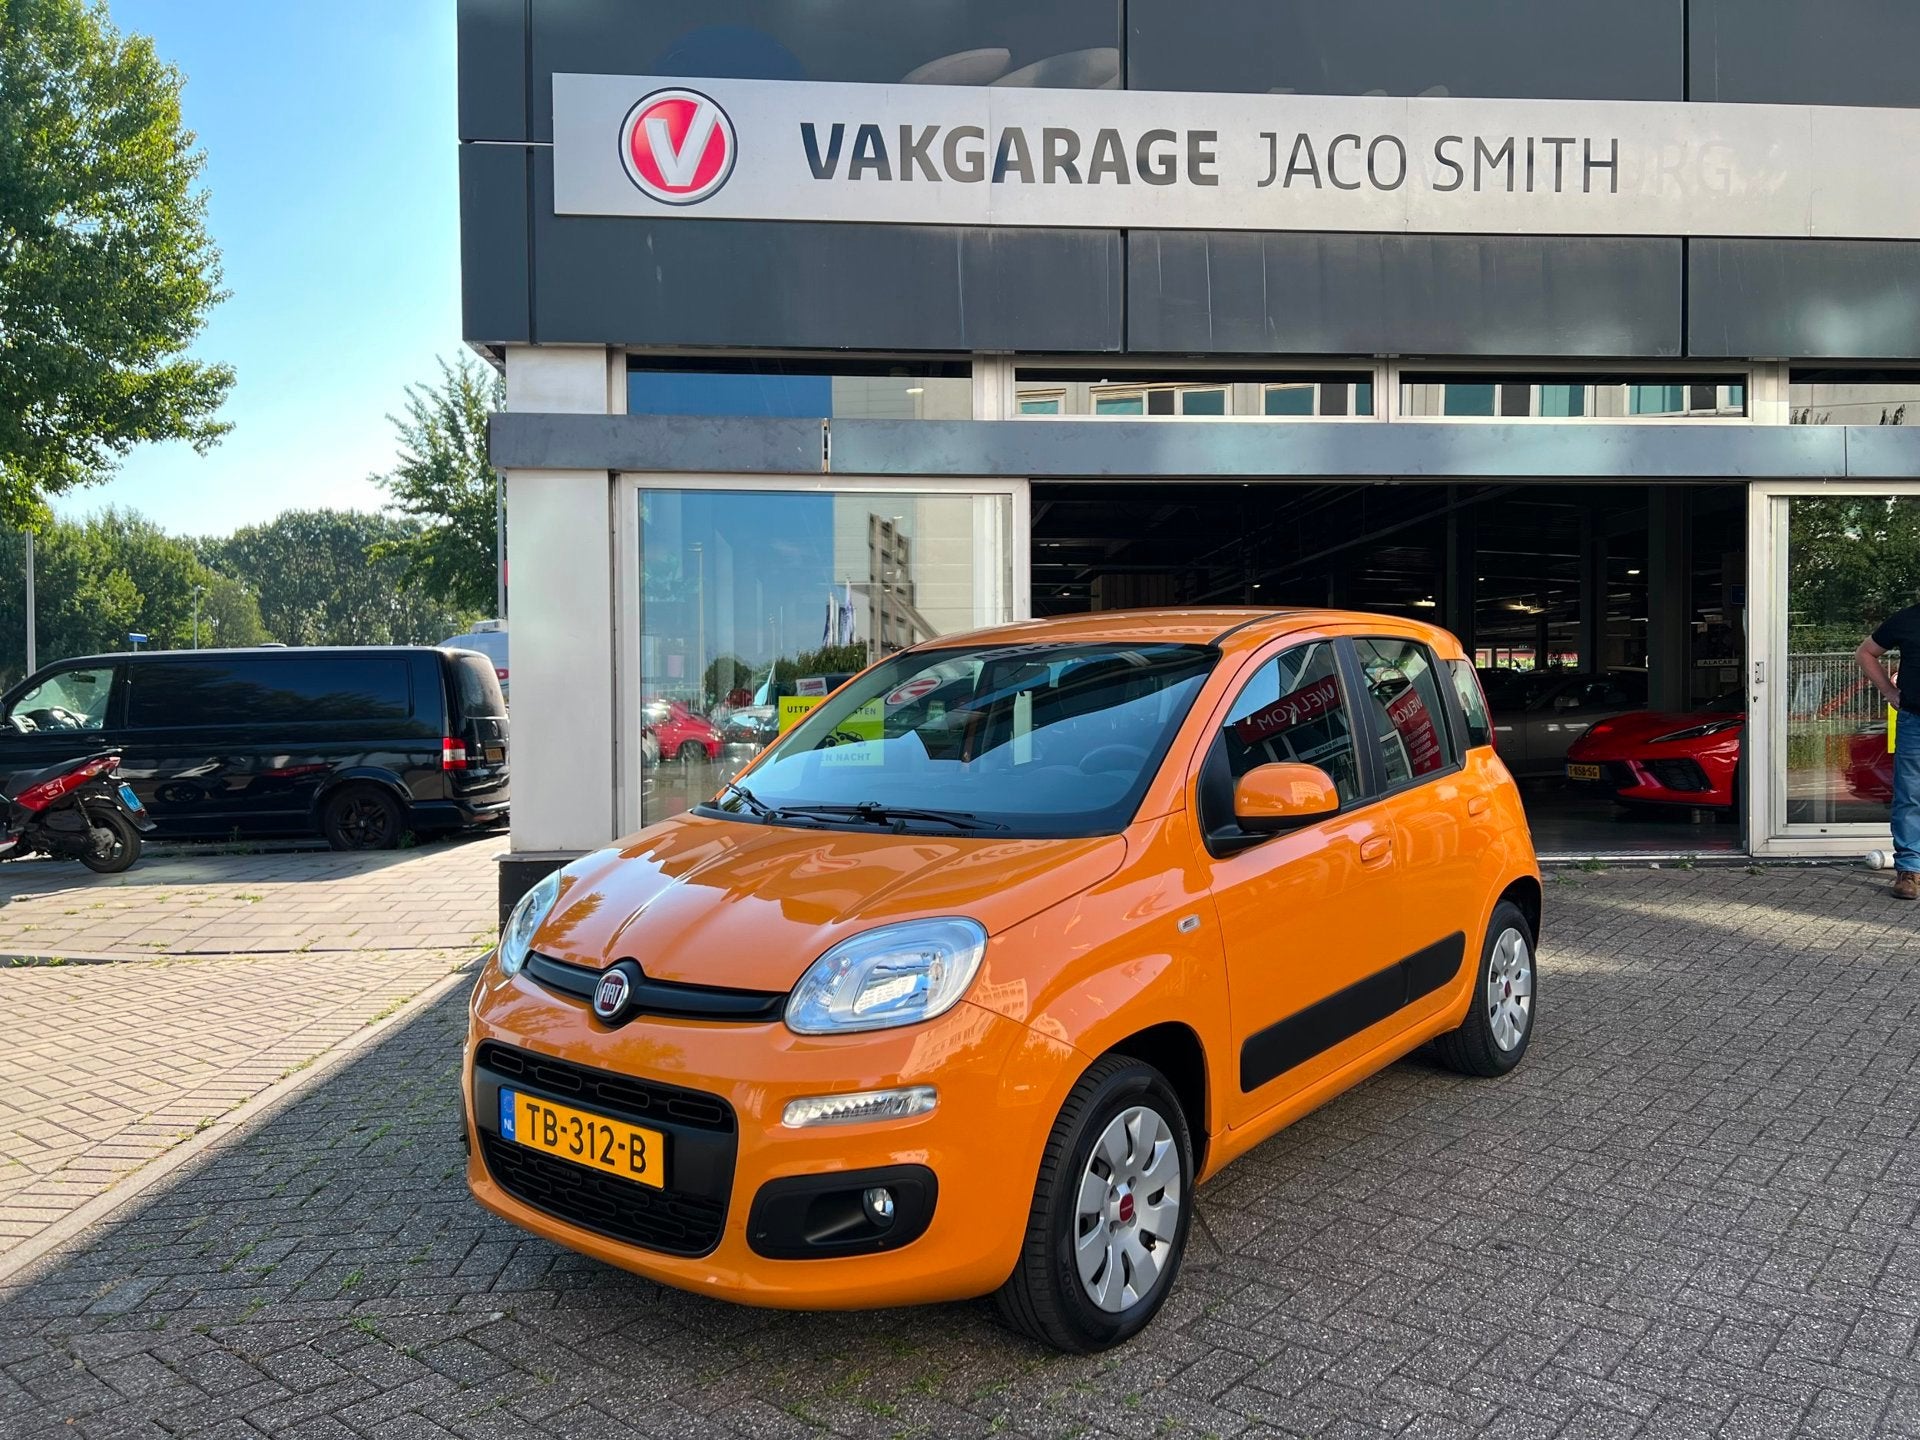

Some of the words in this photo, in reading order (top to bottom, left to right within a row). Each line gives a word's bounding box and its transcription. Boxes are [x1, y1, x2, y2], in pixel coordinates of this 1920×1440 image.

[800, 121, 1220, 187] VAKGARAGE
[1257, 131, 1407, 191] JACO
[1432, 135, 1619, 194] SMITH
[836, 752, 872, 761] NACHT
[600, 982, 621, 1005] FIAT
[503, 1118, 514, 1132] NL
[526, 1103, 647, 1174] TB-312-B
